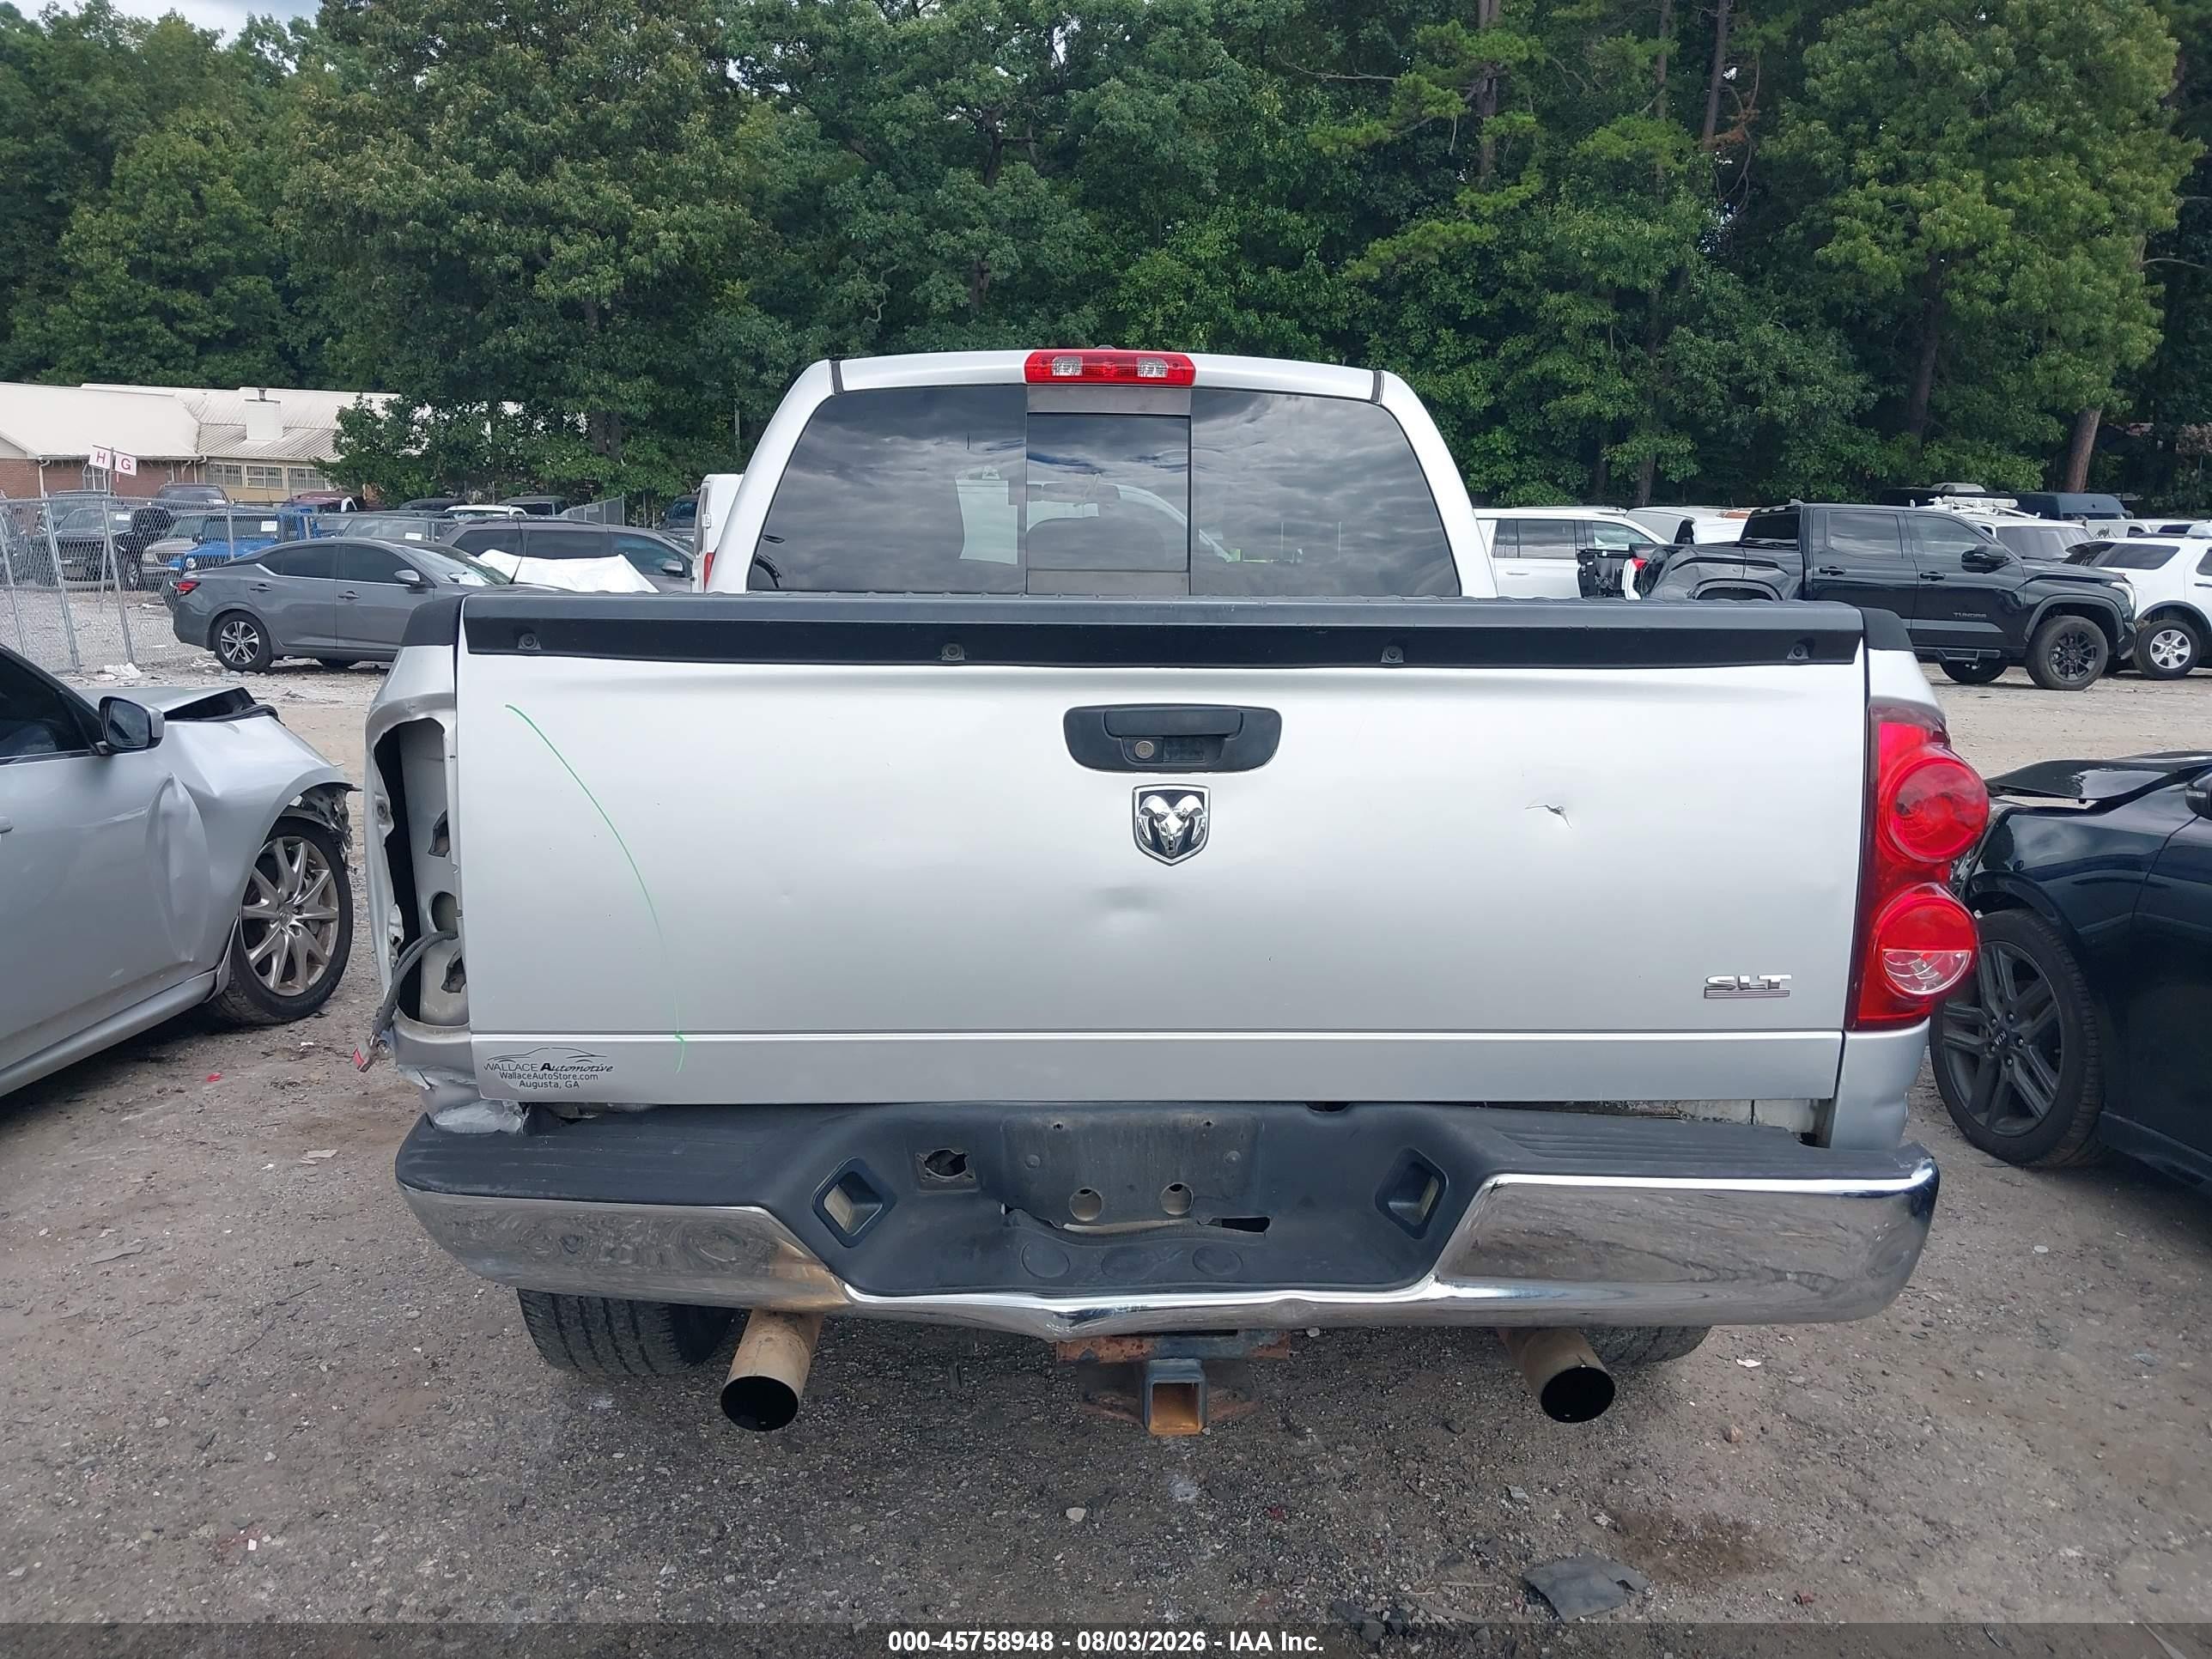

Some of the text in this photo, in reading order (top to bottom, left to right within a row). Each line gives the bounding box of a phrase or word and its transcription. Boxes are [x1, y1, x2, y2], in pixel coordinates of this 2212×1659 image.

[96, 451, 106, 465] H
[121, 458, 131, 471] G
[1705, 974, 1792, 990] SLT
[483, 1062, 614, 1073] WALLACE Automotive
[499, 1072, 599, 1080] WallaceAutoStore.com
[519, 1079, 580, 1090] Augusta, GA
